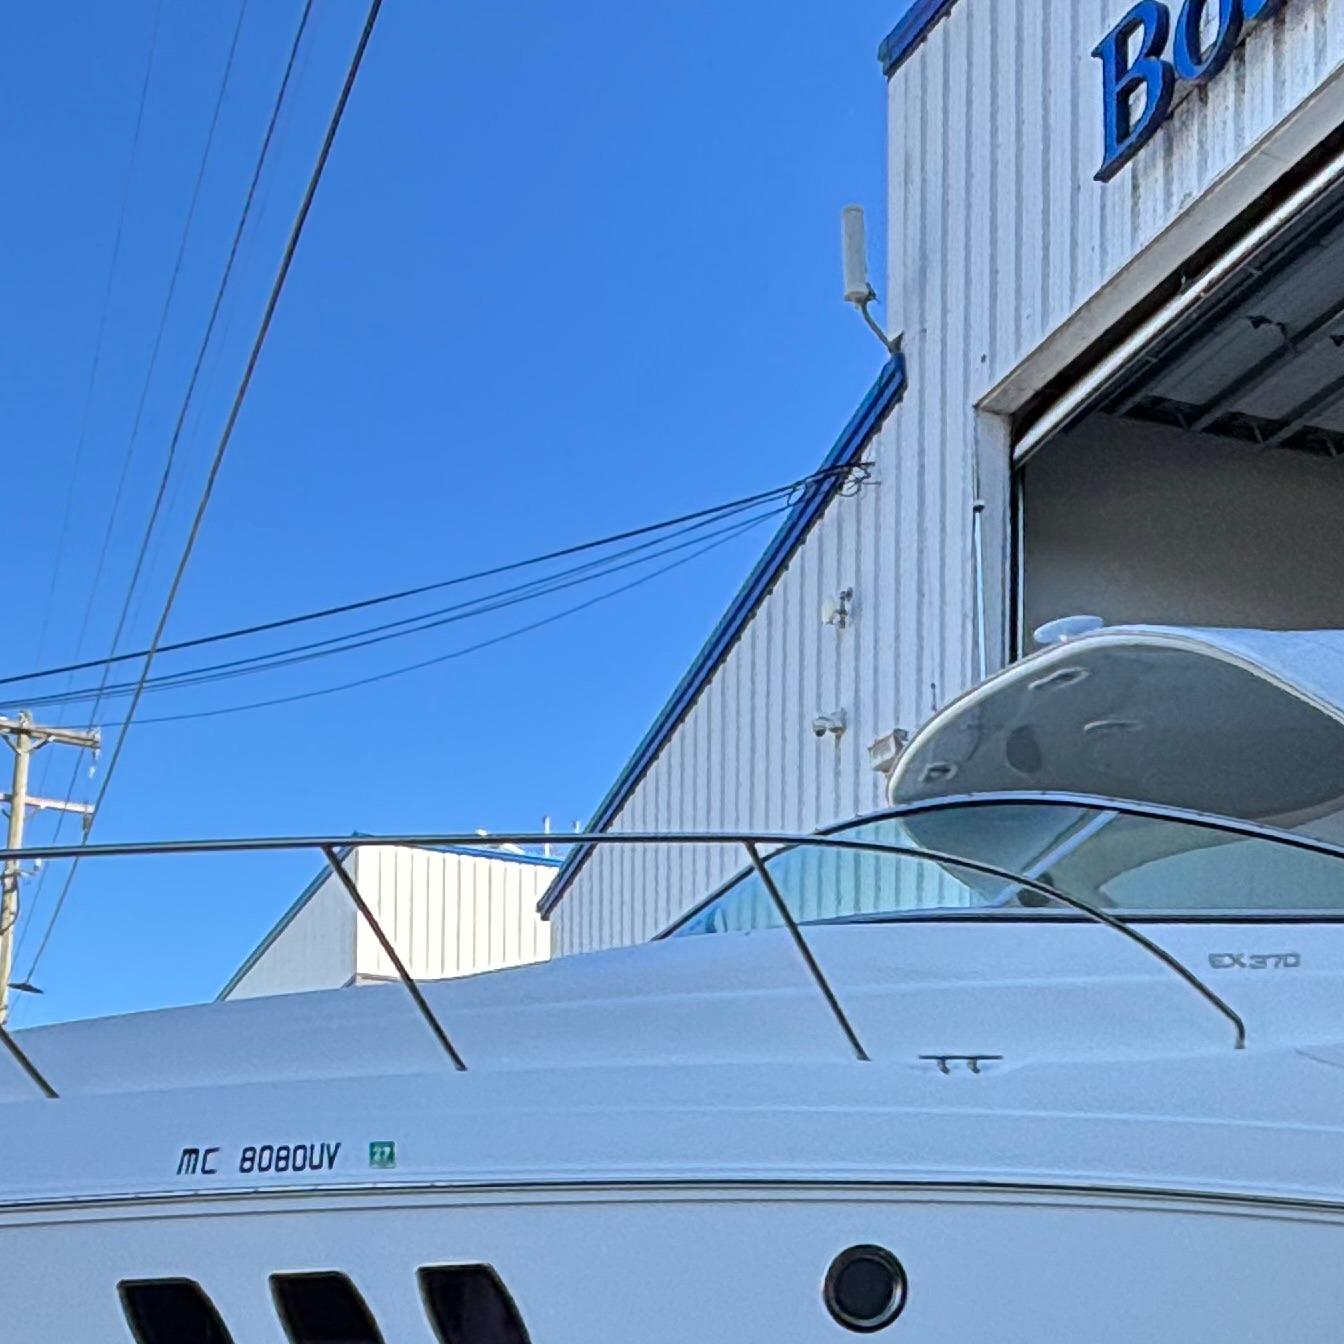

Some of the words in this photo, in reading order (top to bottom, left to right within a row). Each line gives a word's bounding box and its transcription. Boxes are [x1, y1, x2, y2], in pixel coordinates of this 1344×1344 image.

[1091, 0, 1287, 182] BO
[177, 1147, 220, 1175] MC
[239, 1142, 342, 1173] 8080UV
